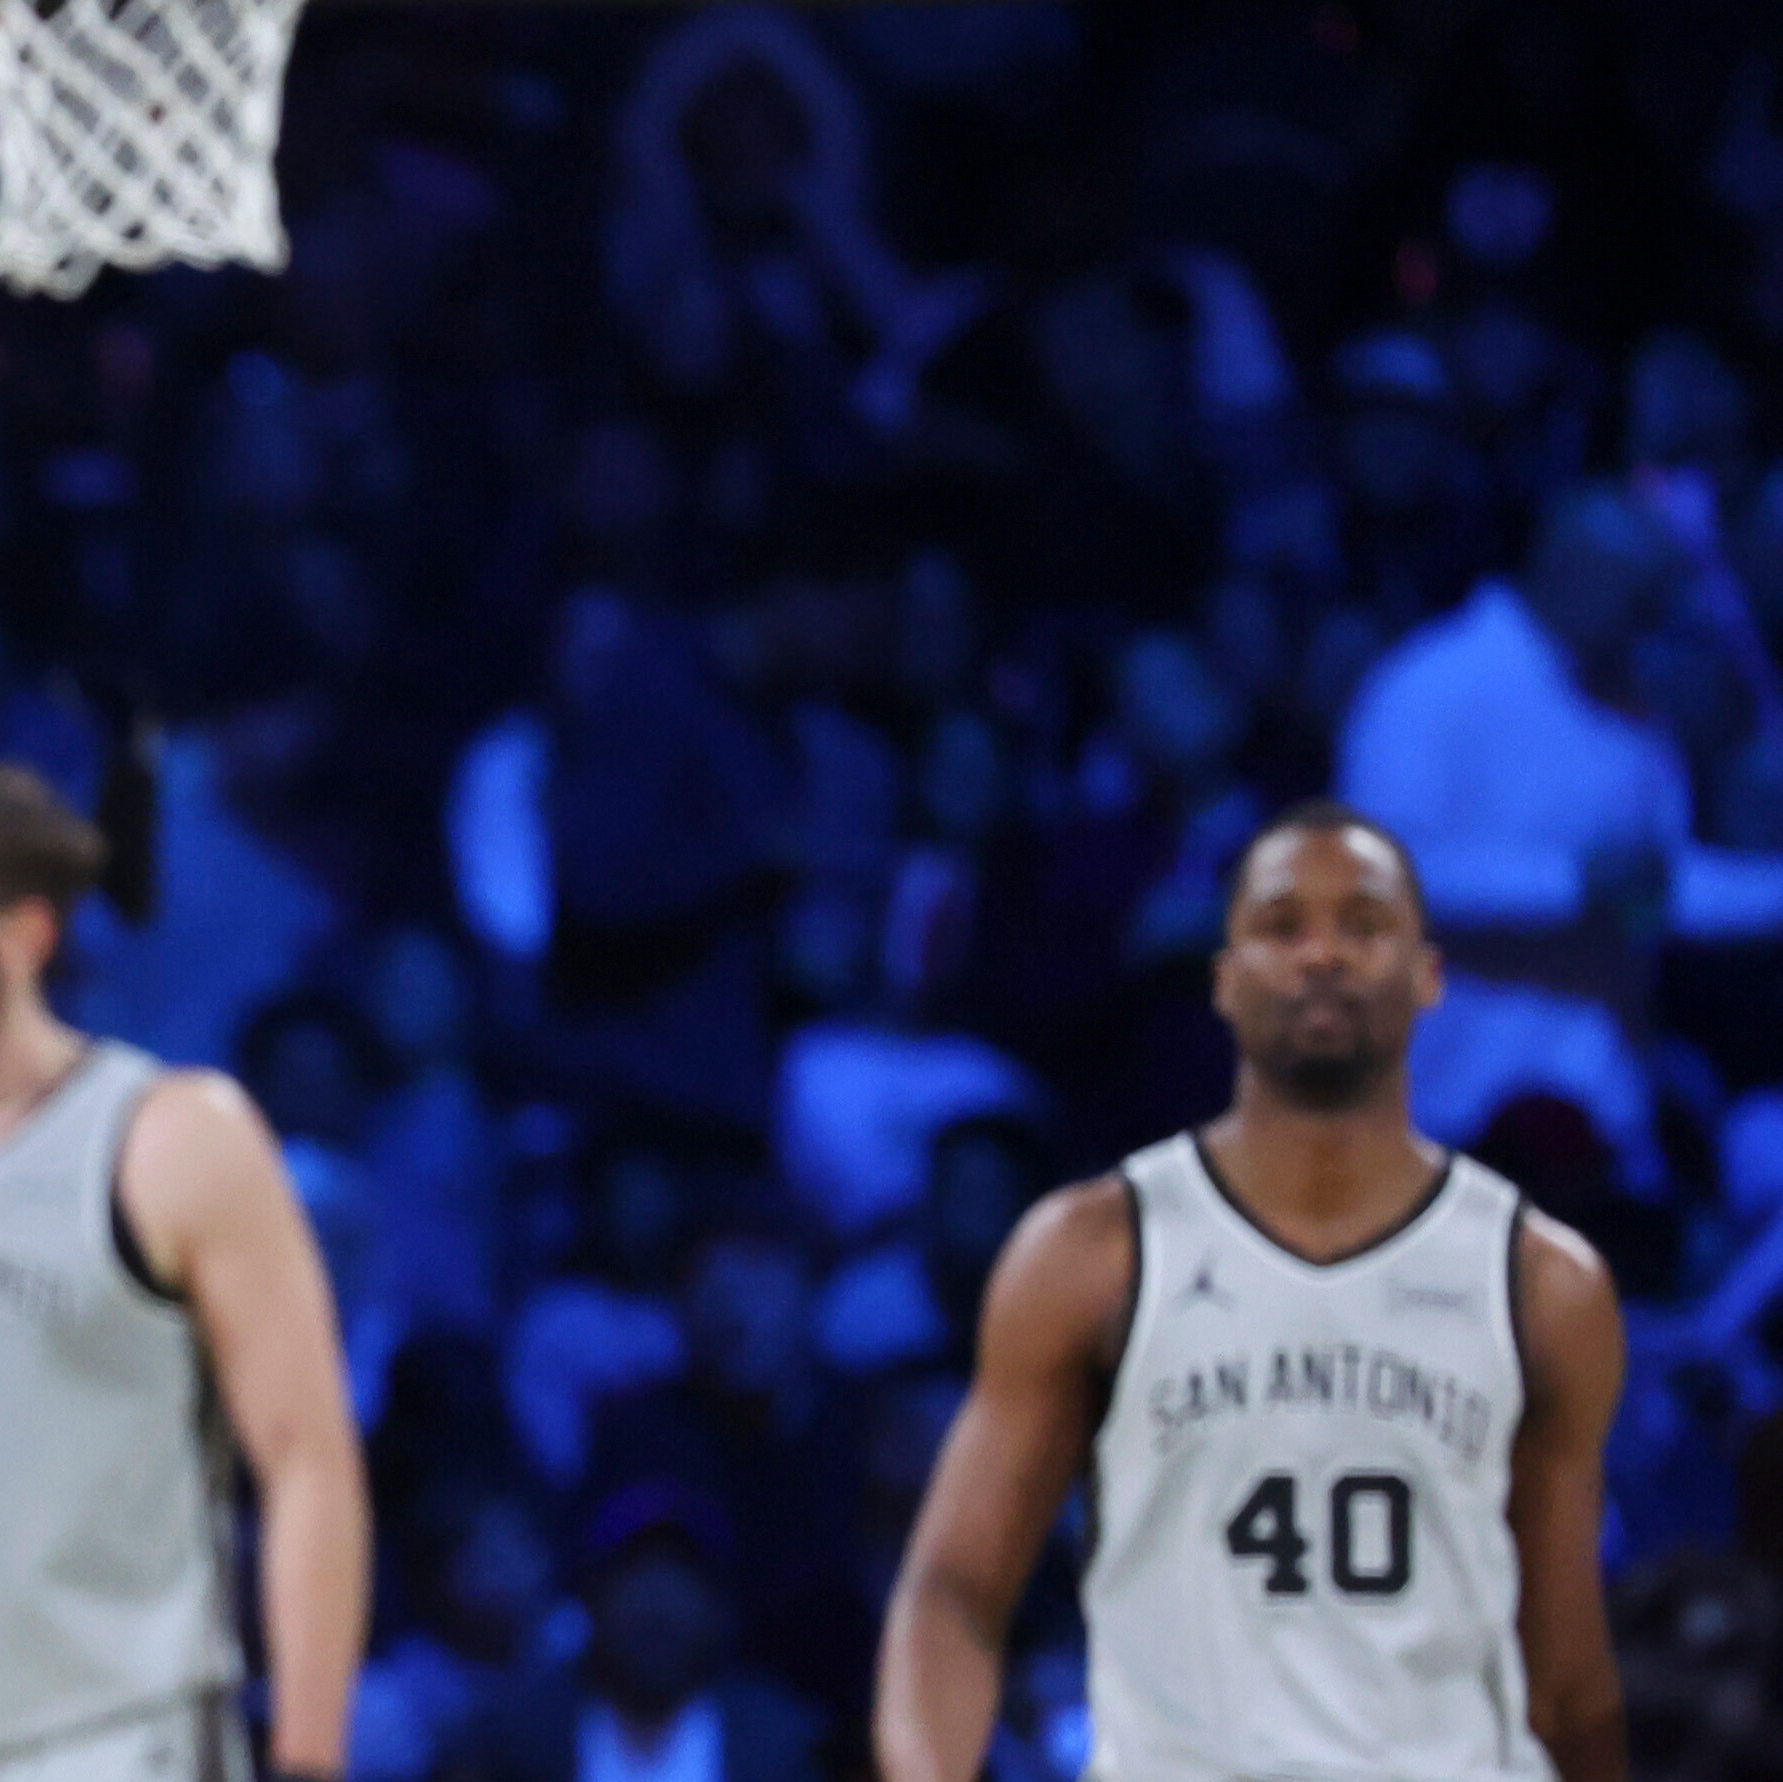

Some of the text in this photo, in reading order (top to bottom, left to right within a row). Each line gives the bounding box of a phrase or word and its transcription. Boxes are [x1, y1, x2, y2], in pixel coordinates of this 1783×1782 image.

[1148, 1342, 1491, 1464] SAN ANTONIO
[1225, 1473, 1414, 1596] 40
